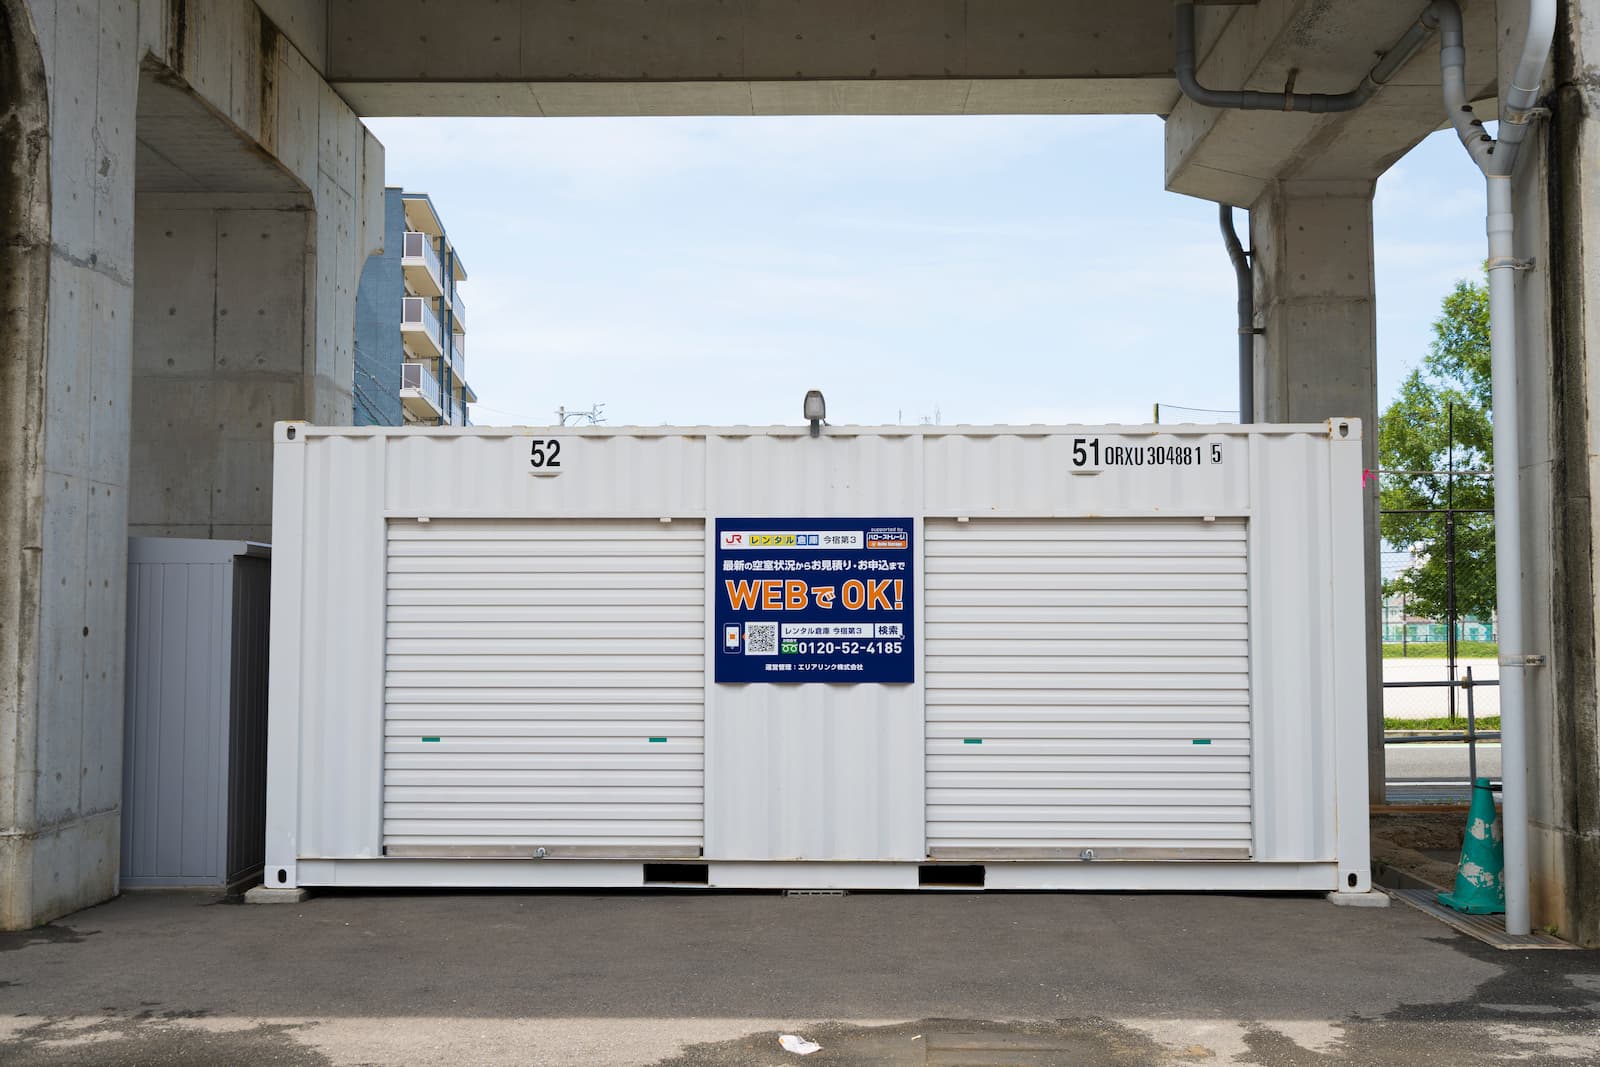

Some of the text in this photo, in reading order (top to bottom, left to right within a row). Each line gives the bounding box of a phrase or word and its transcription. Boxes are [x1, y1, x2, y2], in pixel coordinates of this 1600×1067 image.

[530, 439, 561, 468] 52
[1072, 438, 1100, 467] 51
[1105, 444, 1222, 466] ORXU 304881 5
[725, 534, 742, 544] JR
[878, 625, 899, 636] 検索
[798, 641, 903, 655] 0120-52-4185
